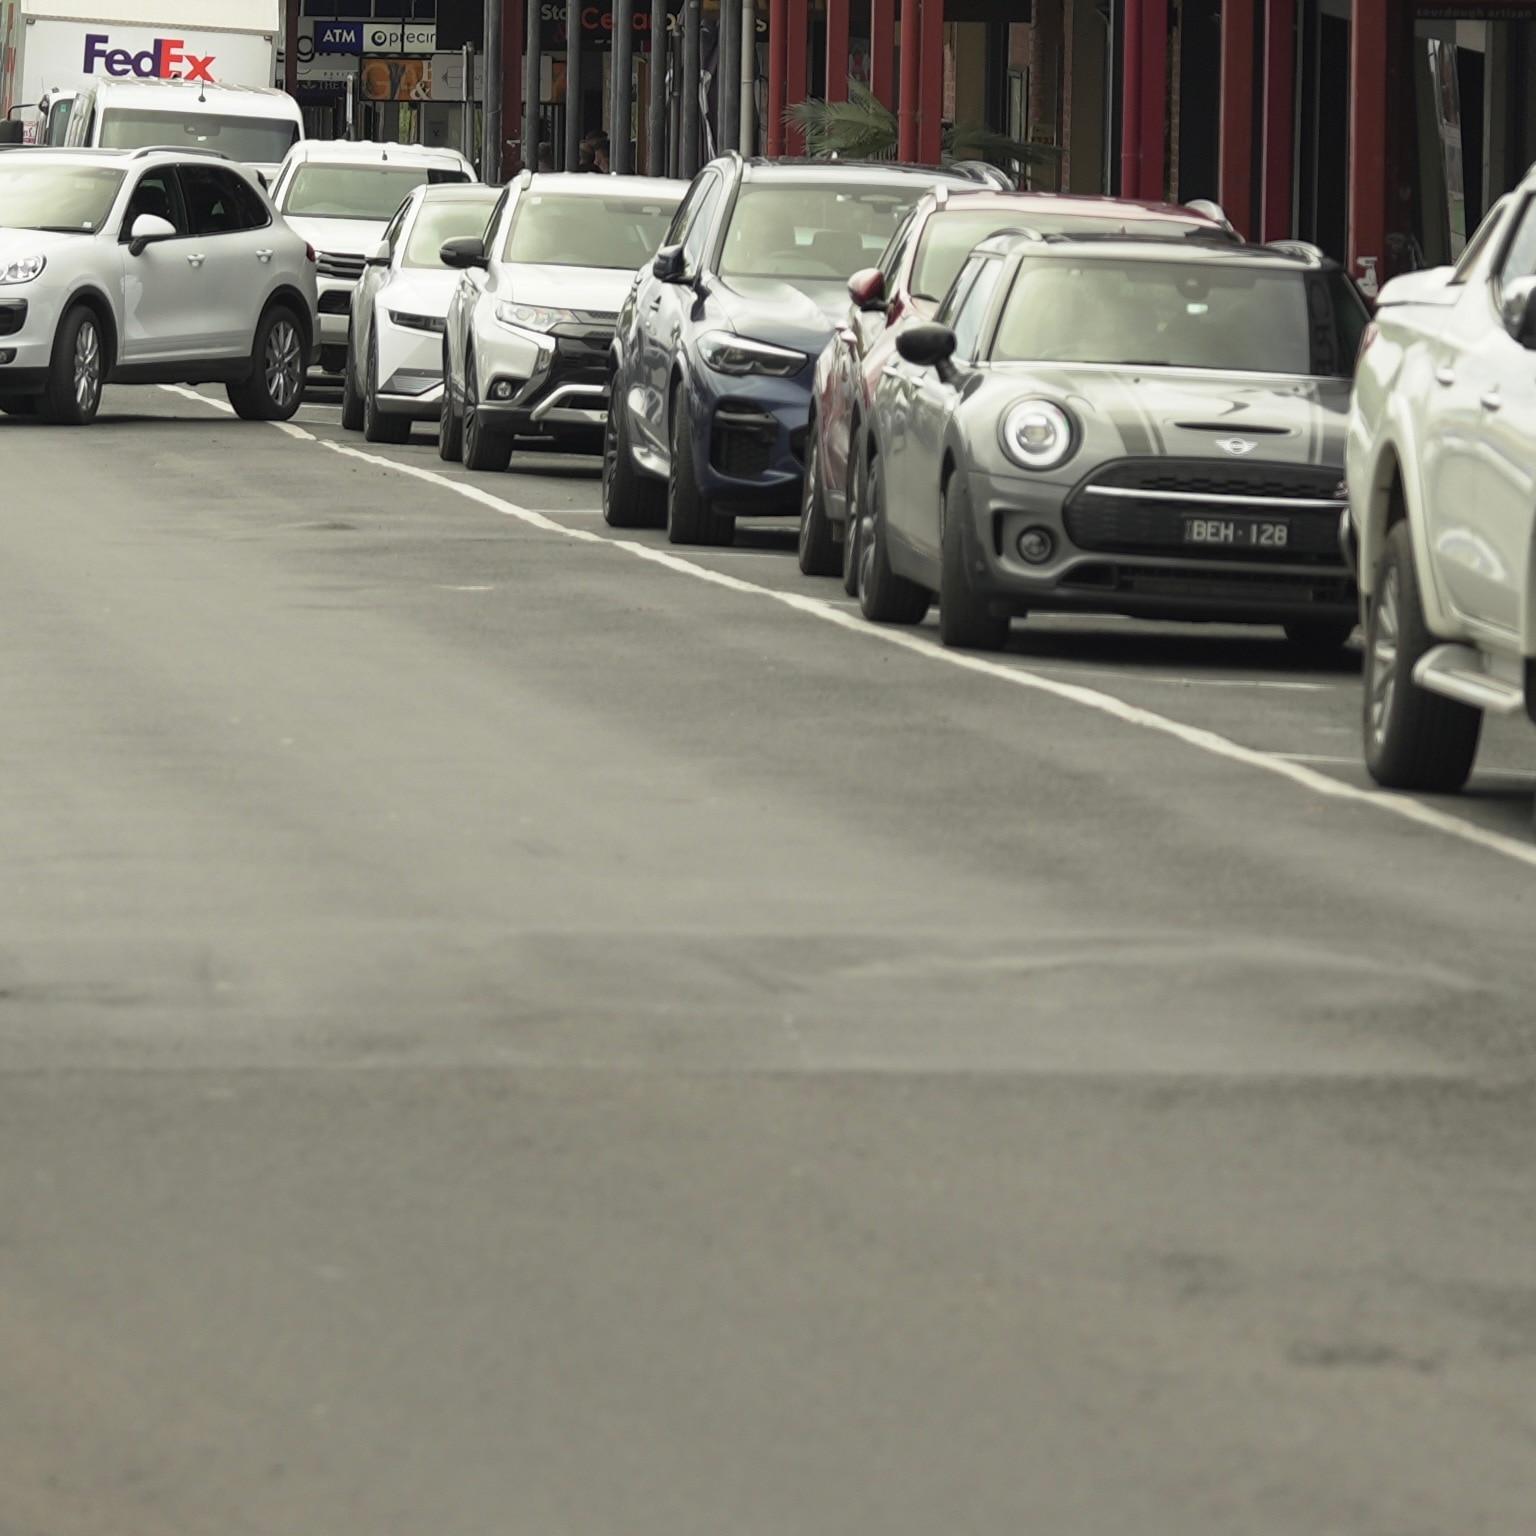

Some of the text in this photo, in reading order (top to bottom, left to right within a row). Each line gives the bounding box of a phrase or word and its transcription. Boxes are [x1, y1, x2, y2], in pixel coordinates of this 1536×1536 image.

[322, 28, 356, 44] ATM
[82, 33, 216, 83] FedEx
[1192, 519, 1288, 546] BEH 128
